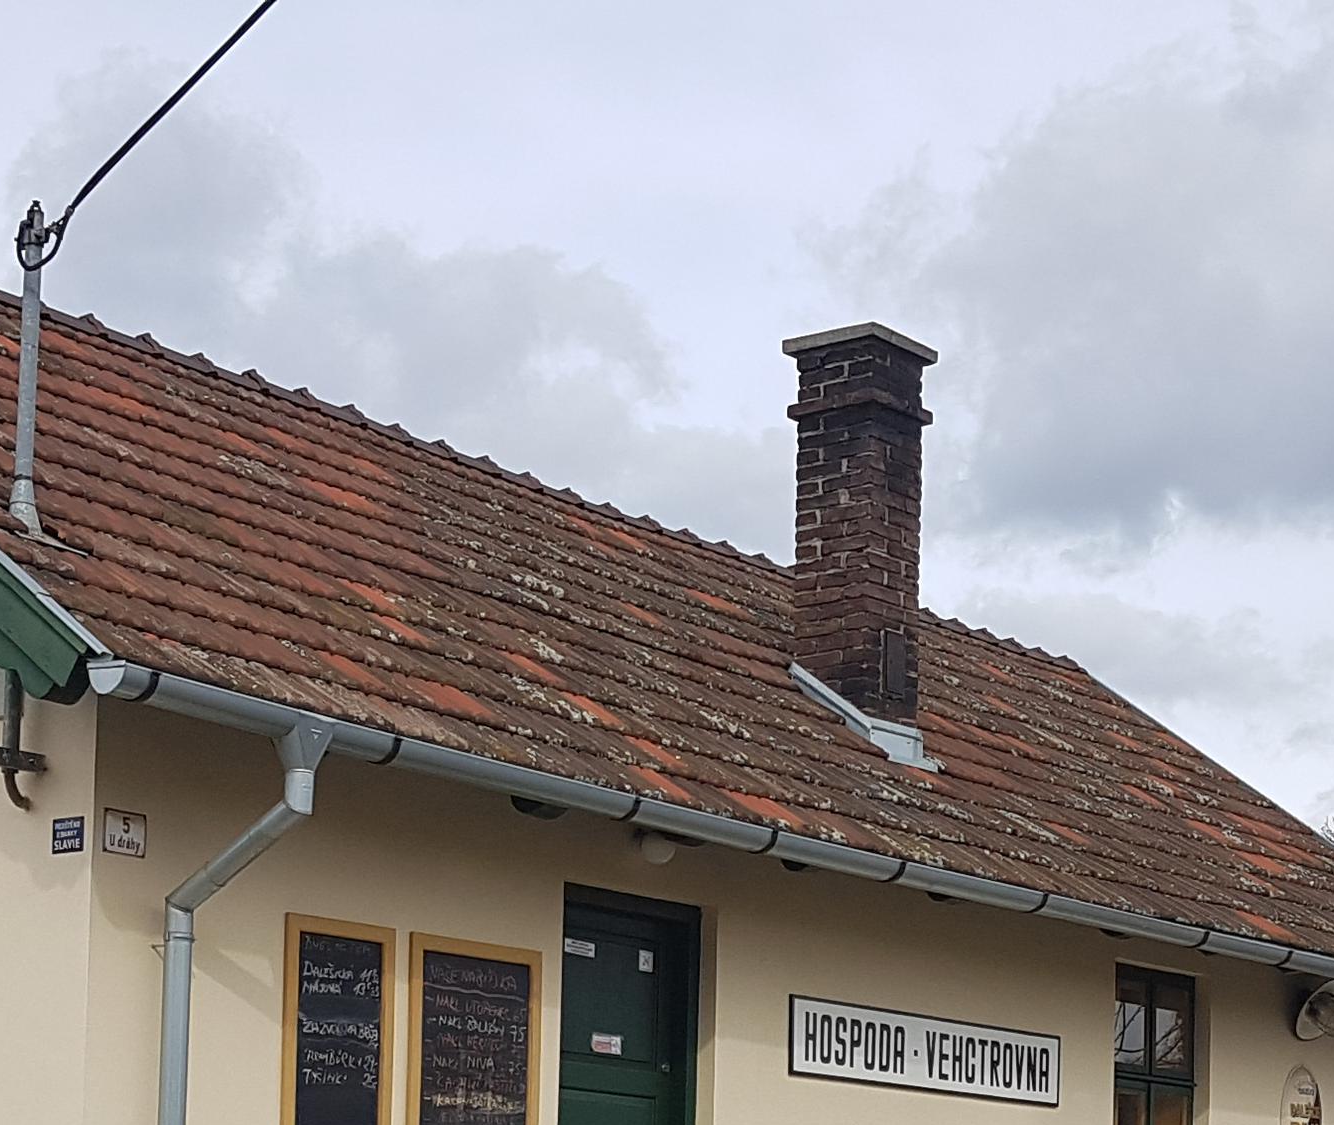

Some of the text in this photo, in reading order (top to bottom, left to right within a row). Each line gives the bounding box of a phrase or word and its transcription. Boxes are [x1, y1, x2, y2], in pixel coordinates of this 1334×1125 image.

[122, 816, 131, 834] 5
[54, 838, 81, 850] SLAVIE
[109, 834, 116, 846] U
[804, 1011, 1050, 1093] HOSPODA VEHCTROVNA
